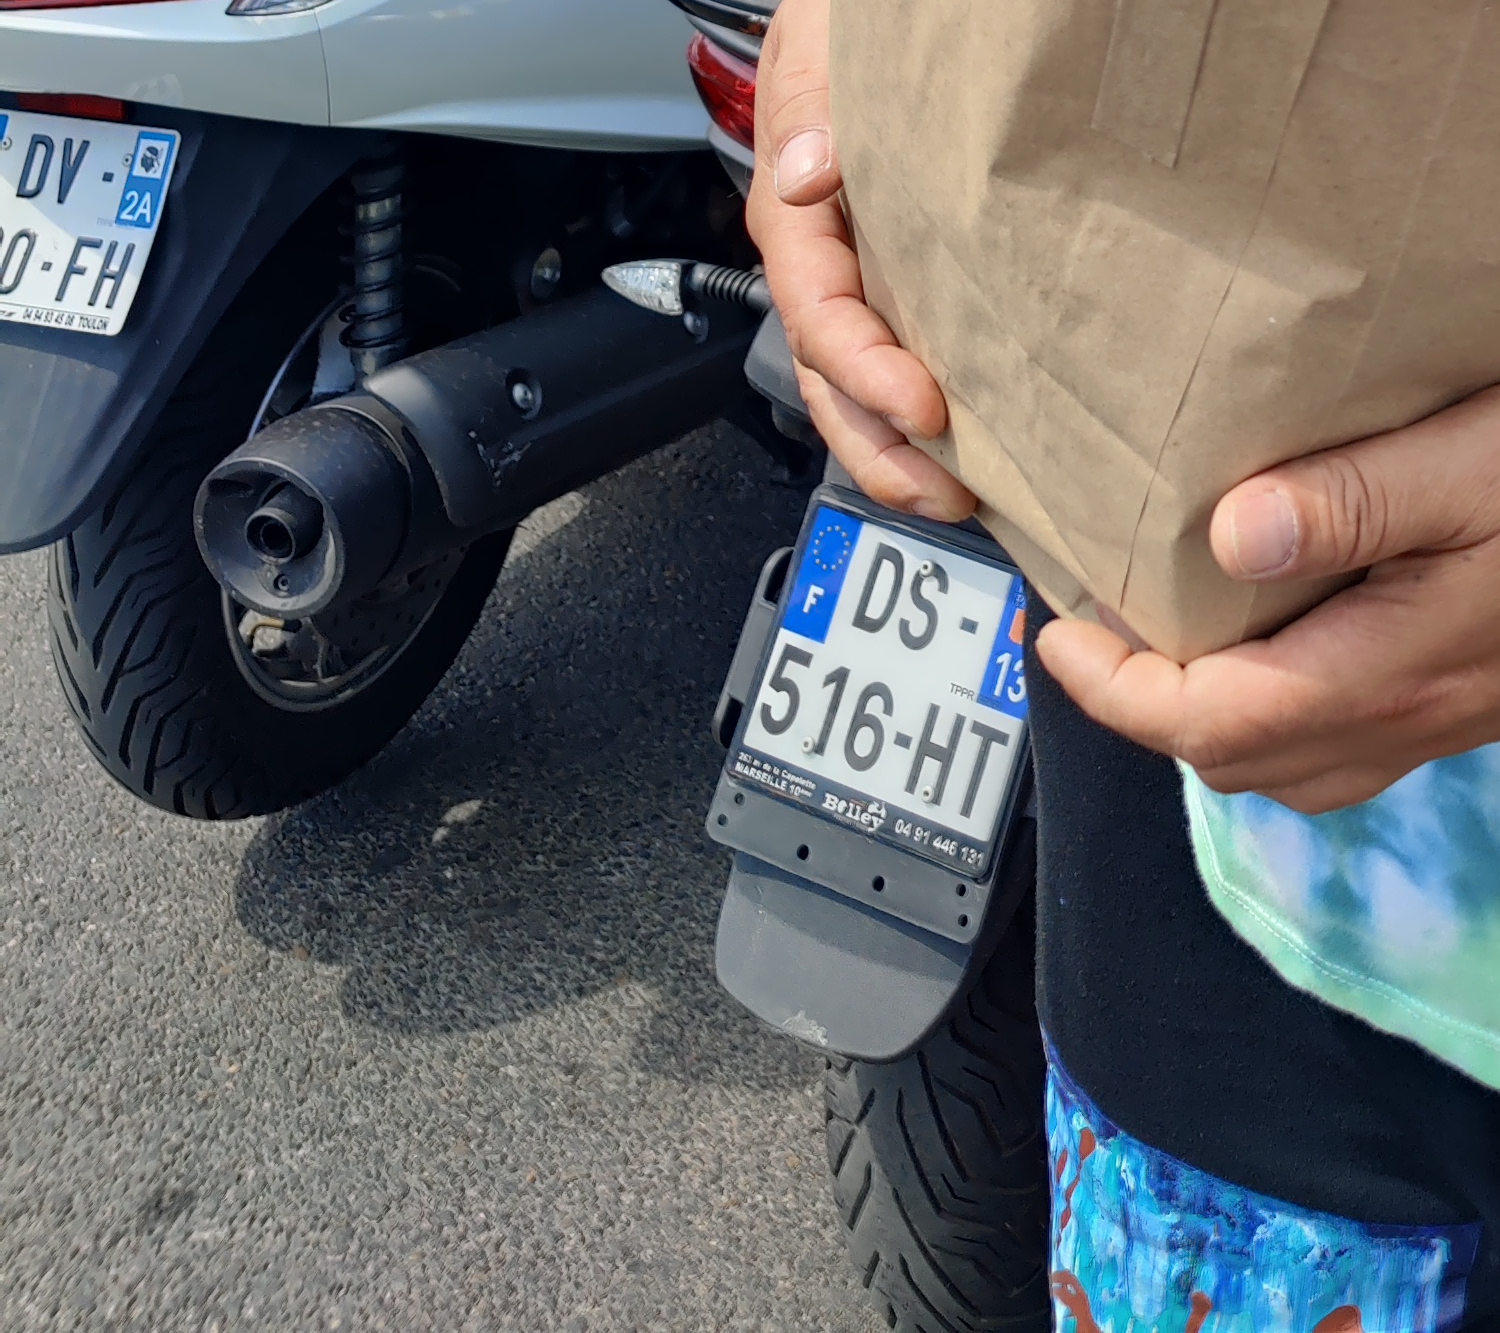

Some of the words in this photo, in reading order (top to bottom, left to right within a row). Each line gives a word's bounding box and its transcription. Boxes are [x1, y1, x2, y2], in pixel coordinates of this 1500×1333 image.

[119, 190, 152, 224] 2A
[0, 227, 136, 309] 0-FH
[802, 584, 825, 614] F
[950, 682, 975, 702] TPPR
[993, 651, 1027, 704] 13
[760, 643, 1009, 819] 516-HT
[735, 761, 787, 792] MARSEILLE
[894, 818, 912, 838] 04
[913, 826, 931, 845] 91
